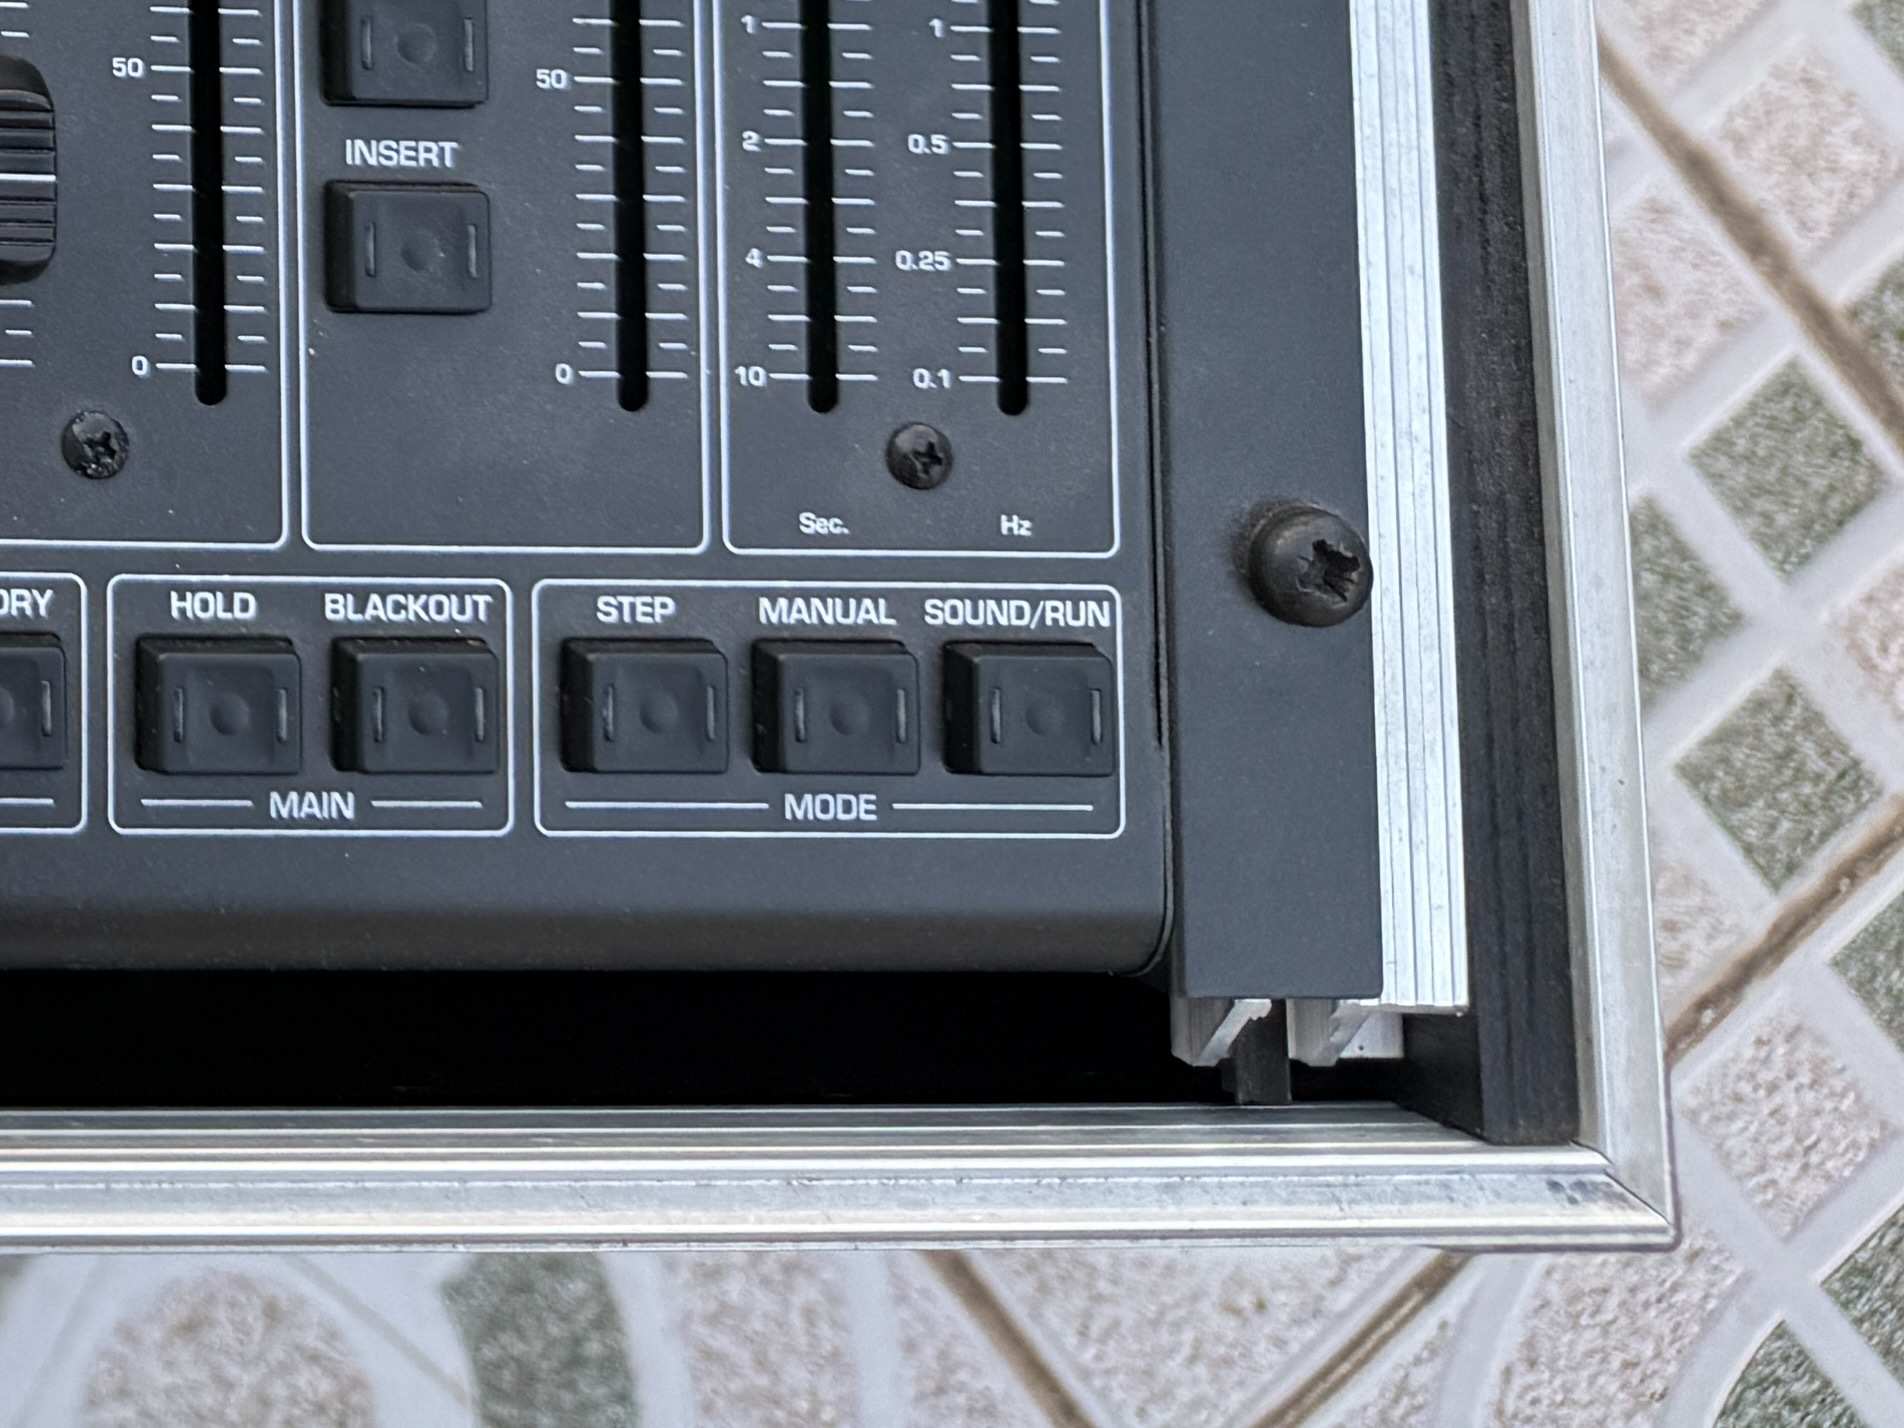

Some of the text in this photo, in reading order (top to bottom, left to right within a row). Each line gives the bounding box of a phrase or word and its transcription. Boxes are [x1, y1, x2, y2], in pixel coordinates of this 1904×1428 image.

[741, 15, 754, 33] 1
[929, 18, 943, 38] 1
[742, 131, 759, 151] 2
[908, 134, 948, 154] 0.5
[346, 139, 458, 167] INSERT
[745, 248, 762, 268] 4
[896, 250, 950, 271] 0.25
[735, 366, 766, 387] 10
[913, 368, 950, 389] 0.1
[799, 512, 849, 535] Sec.
[1000, 514, 1032, 536] Hz
[170, 591, 256, 619] HOLD
[325, 593, 492, 622] BLACKOUT
[597, 596, 675, 623] STEP
[759, 597, 896, 625] MANUAL
[924, 598, 1111, 629] SOUND/RUN
[270, 791, 354, 819] MAIN
[785, 794, 877, 821] MODE
